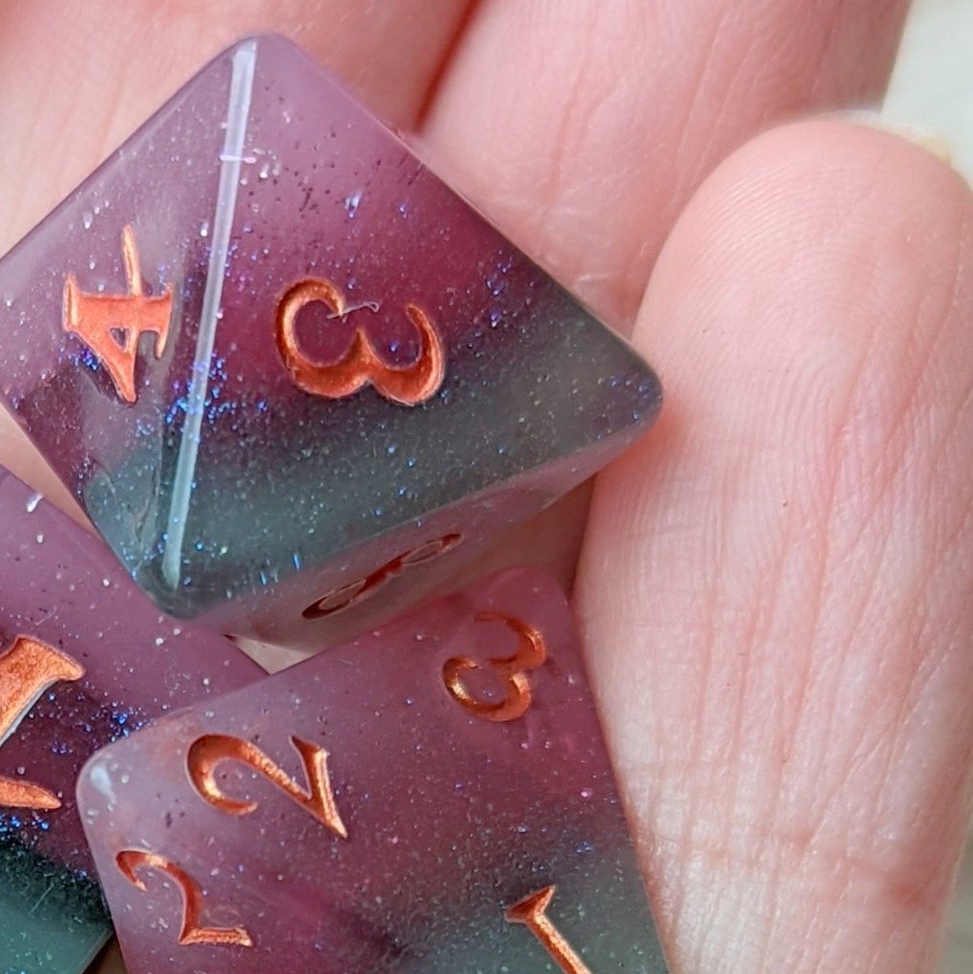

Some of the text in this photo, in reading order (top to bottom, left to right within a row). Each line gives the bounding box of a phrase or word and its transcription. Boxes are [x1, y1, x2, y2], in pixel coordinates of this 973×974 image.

[62, 225, 173, 404] 4
[274, 278, 446, 407] 3
[442, 610, 546, 723] 3
[186, 733, 349, 839] 2
